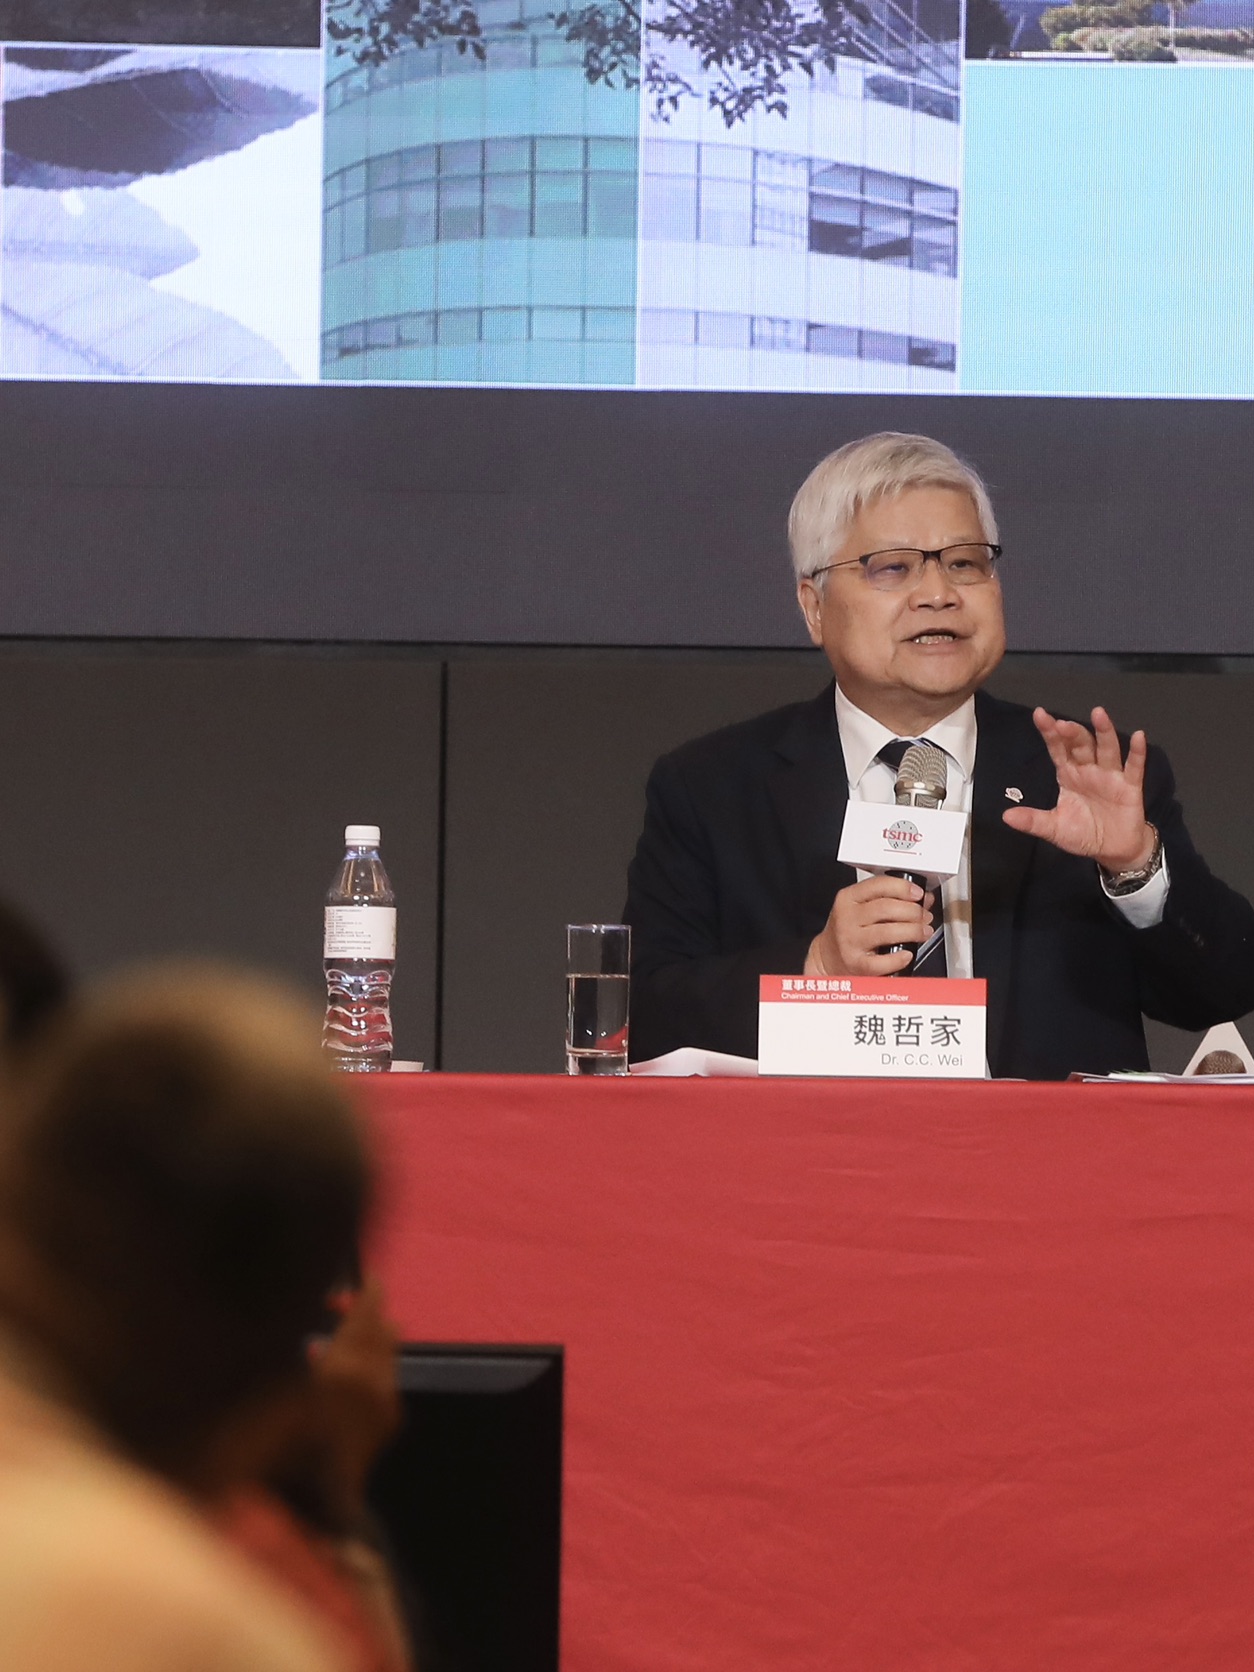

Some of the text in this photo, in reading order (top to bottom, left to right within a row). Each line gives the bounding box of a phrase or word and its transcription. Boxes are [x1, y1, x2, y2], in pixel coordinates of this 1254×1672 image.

[883, 828, 923, 843] tsmc
[782, 979, 852, 992] 董事長暨總裁
[781, 992, 815, 1000] Chairman
[816, 993, 829, 1001] and
[831, 993, 850, 1001] Chief
[885, 994, 909, 1002] Officer
[854, 1014, 961, 1047] 魏哲家
[881, 1053, 963, 1066] Dr. C.C. Wei
